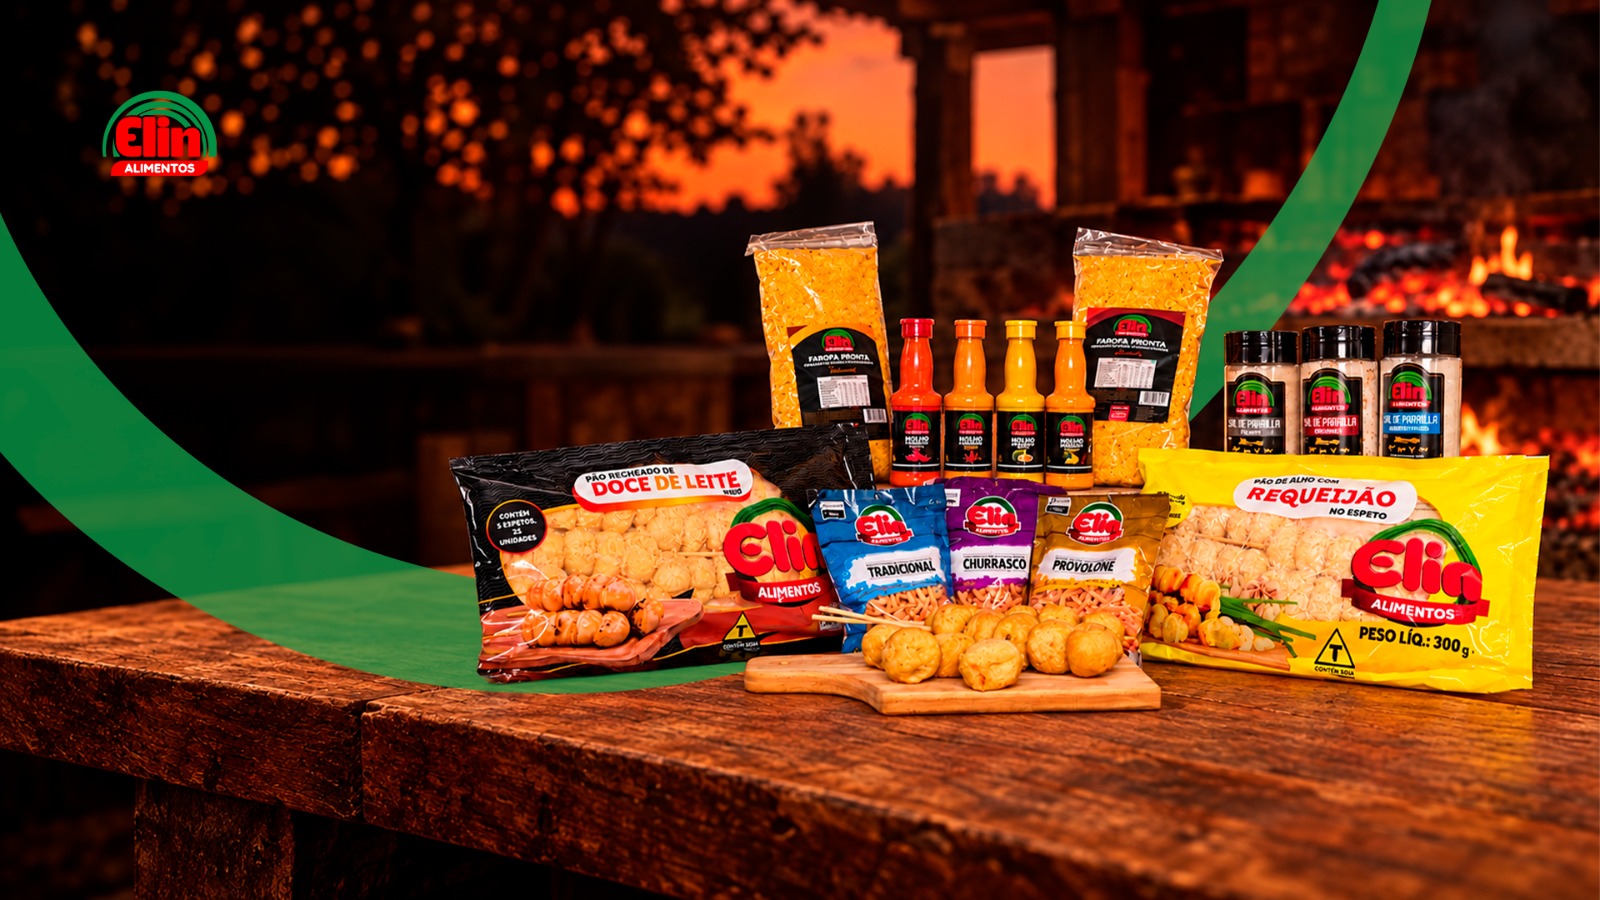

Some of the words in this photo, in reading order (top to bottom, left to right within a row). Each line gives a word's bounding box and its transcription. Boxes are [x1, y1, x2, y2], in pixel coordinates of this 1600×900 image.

[1311, 386, 1345, 403] Elin
[1392, 382, 1426, 400] Elin
[609, 466, 661, 480] RECHEADO
[662, 466, 675, 475] DE
[1289, 476, 1315, 484] ALHO
[591, 476, 652, 497] DOCE
[654, 475, 682, 491] DE
[684, 471, 741, 489] LEITE
[1246, 486, 1396, 508] REQUEIJÃO
[967, 505, 1015, 526] Elin
[1329, 508, 1345, 516] NO
[1347, 508, 1387, 520] ESPETO
[855, 514, 907, 536] Elin
[867, 560, 936, 578] TRADICIONAL
[963, 558, 1026, 570] CHURRASCO
[1052, 560, 1116, 573] PROVOLONE
[1351, 537, 1483, 603] Elin
[758, 582, 821, 600] ALIMENTOS
[1371, 598, 1455, 621] ALIMENTOS
[736, 625, 748, 638] T
[1359, 626, 1396, 643] PESO
[1399, 628, 1430, 648] LÍQ.:
[1329, 644, 1343, 662] T
